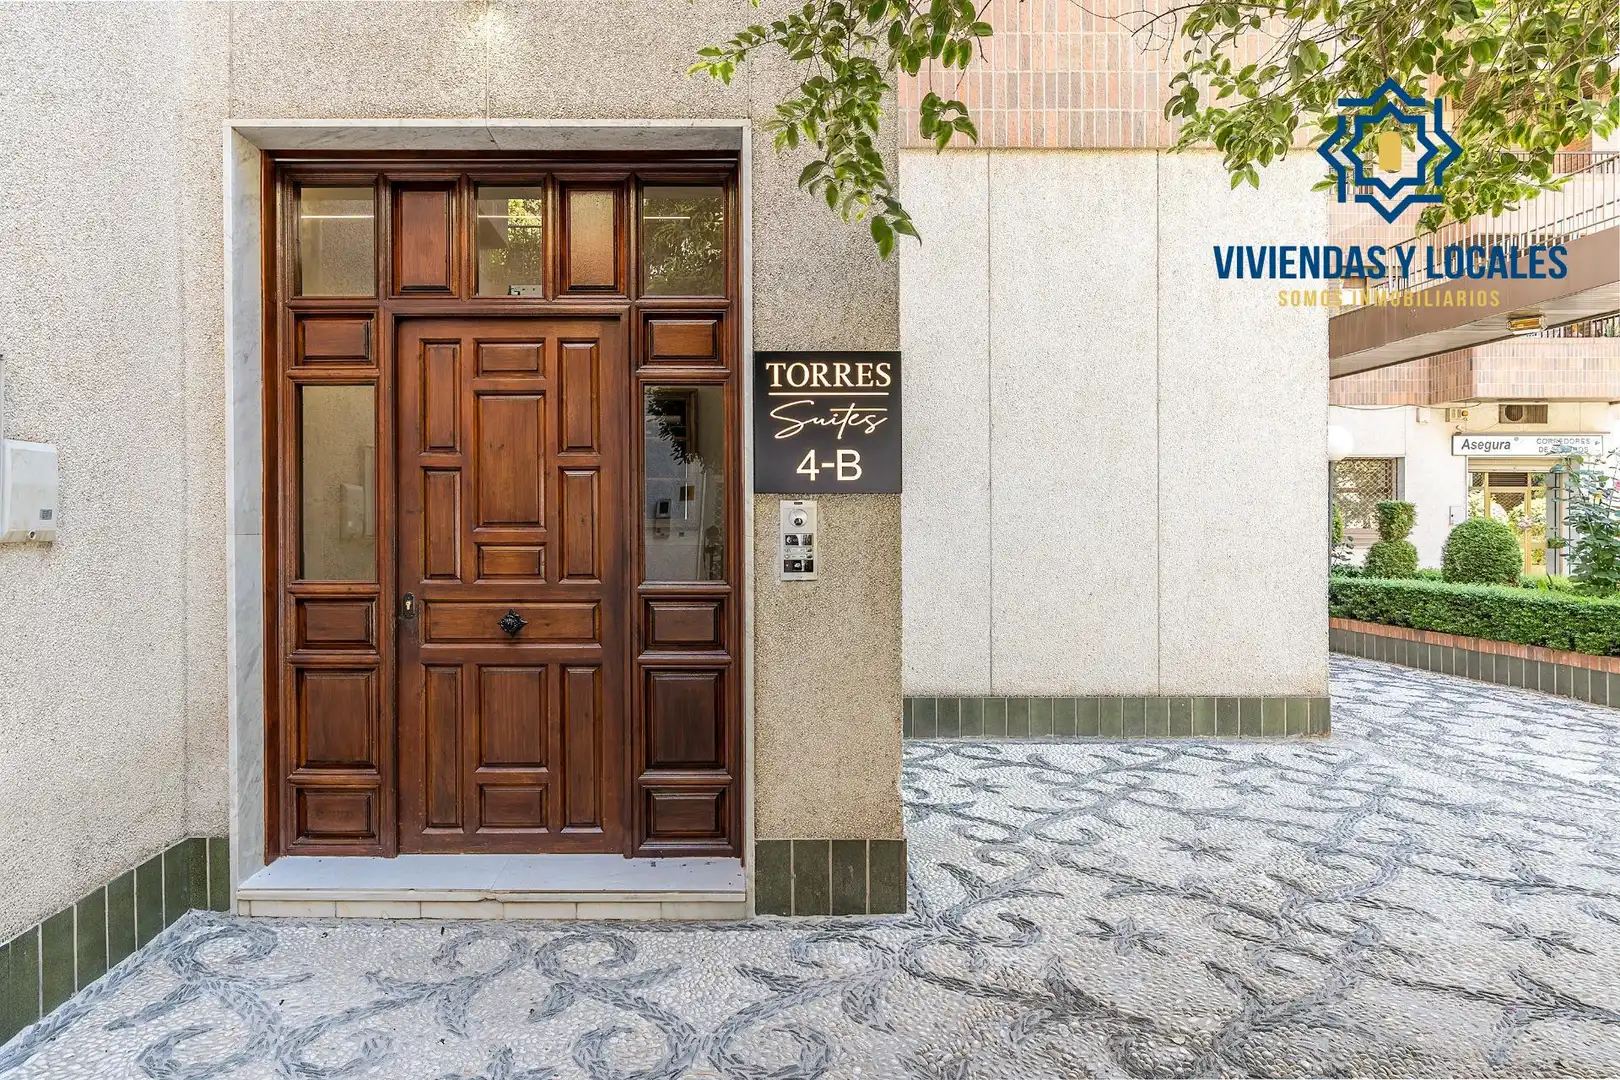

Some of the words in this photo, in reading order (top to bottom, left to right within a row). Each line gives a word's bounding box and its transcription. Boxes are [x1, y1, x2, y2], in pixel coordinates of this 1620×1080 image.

[766, 362, 891, 388] TORRES
[770, 400, 888, 440] Suites
[1461, 438, 1511, 452] Asegura
[796, 449, 863, 481] 4-B
